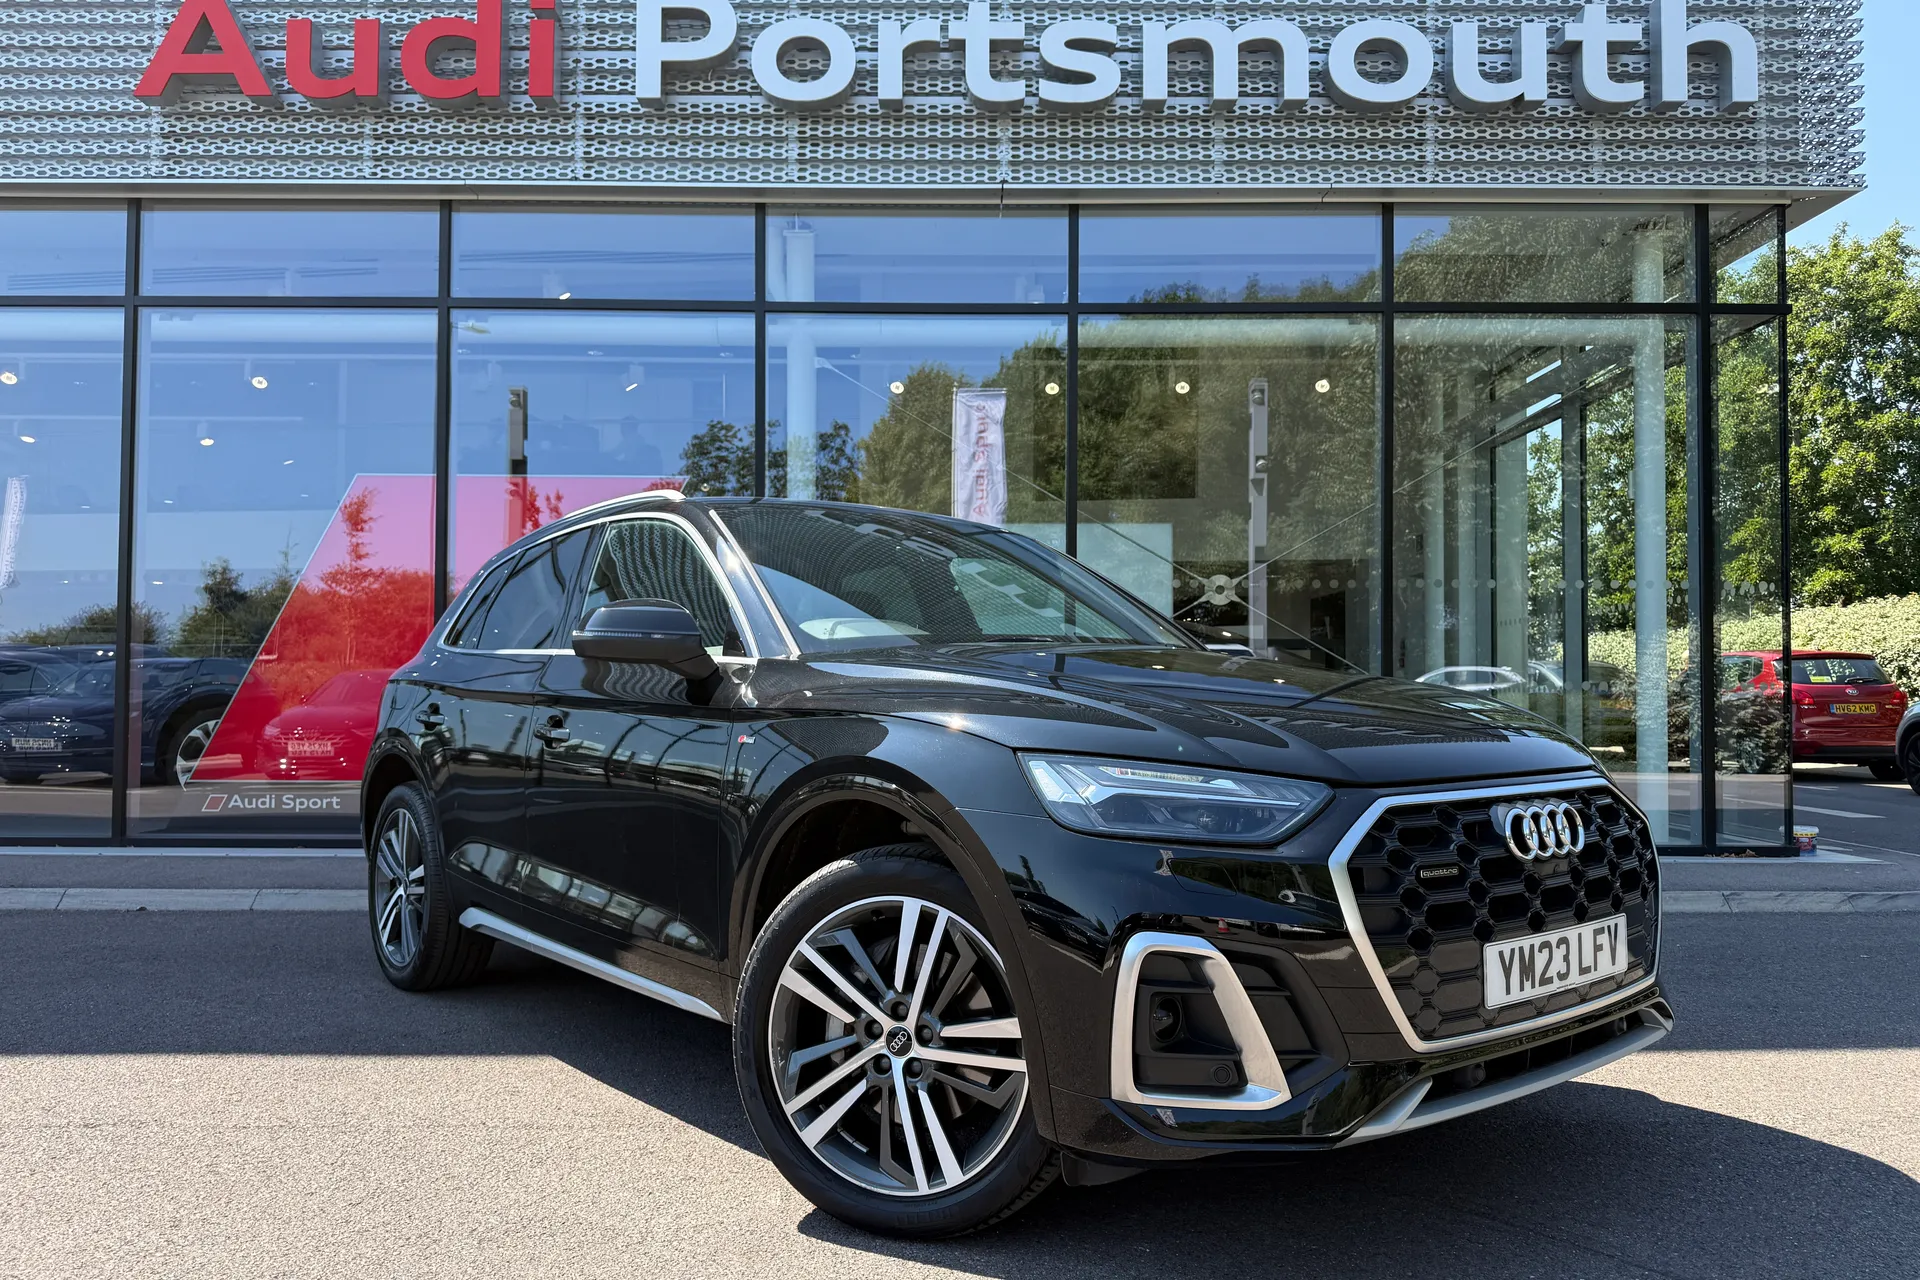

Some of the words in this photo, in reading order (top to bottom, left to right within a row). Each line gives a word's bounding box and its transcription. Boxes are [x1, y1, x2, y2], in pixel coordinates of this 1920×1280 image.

[133, 0, 556, 99] Audi
[635, 0, 1758, 104] Portsmouth
[1835, 704, 1858, 713] HV62
[1859, 704, 1875, 713] KMG
[228, 794, 276, 809] Audi
[282, 794, 341, 812] Sport
[1422, 868, 1458, 877] quattro
[1498, 937, 1570, 995] YM23
[1578, 923, 1618, 976] LFV
